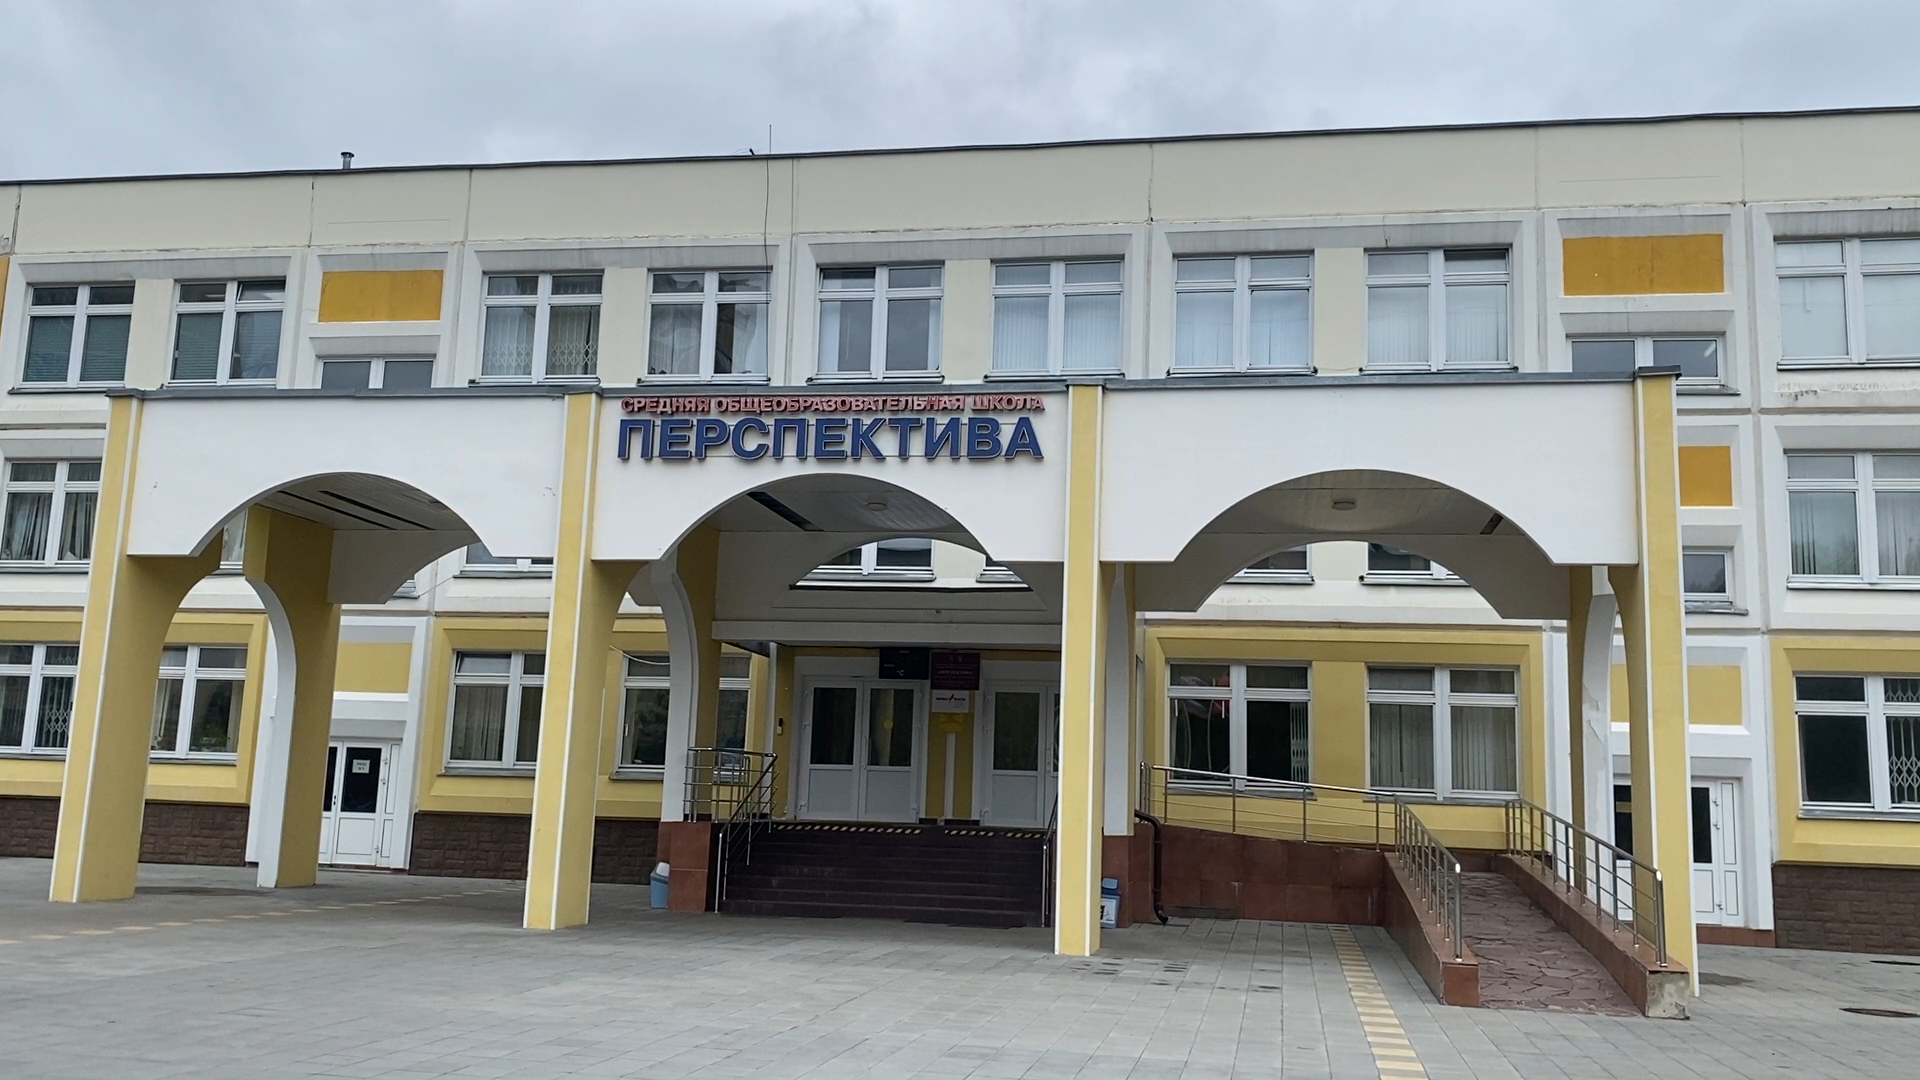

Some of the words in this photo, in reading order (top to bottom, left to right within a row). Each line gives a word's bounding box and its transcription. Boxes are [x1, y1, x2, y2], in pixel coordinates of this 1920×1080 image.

[621, 397, 710, 415] СРЕДНЯЯ
[714, 395, 965, 414] ОБЩЕОБРАЗОВАТЕЛЬНАЯ
[971, 394, 1045, 411] ШКОЛА
[617, 416, 1044, 461] ПЕРСПЕКТИВА
